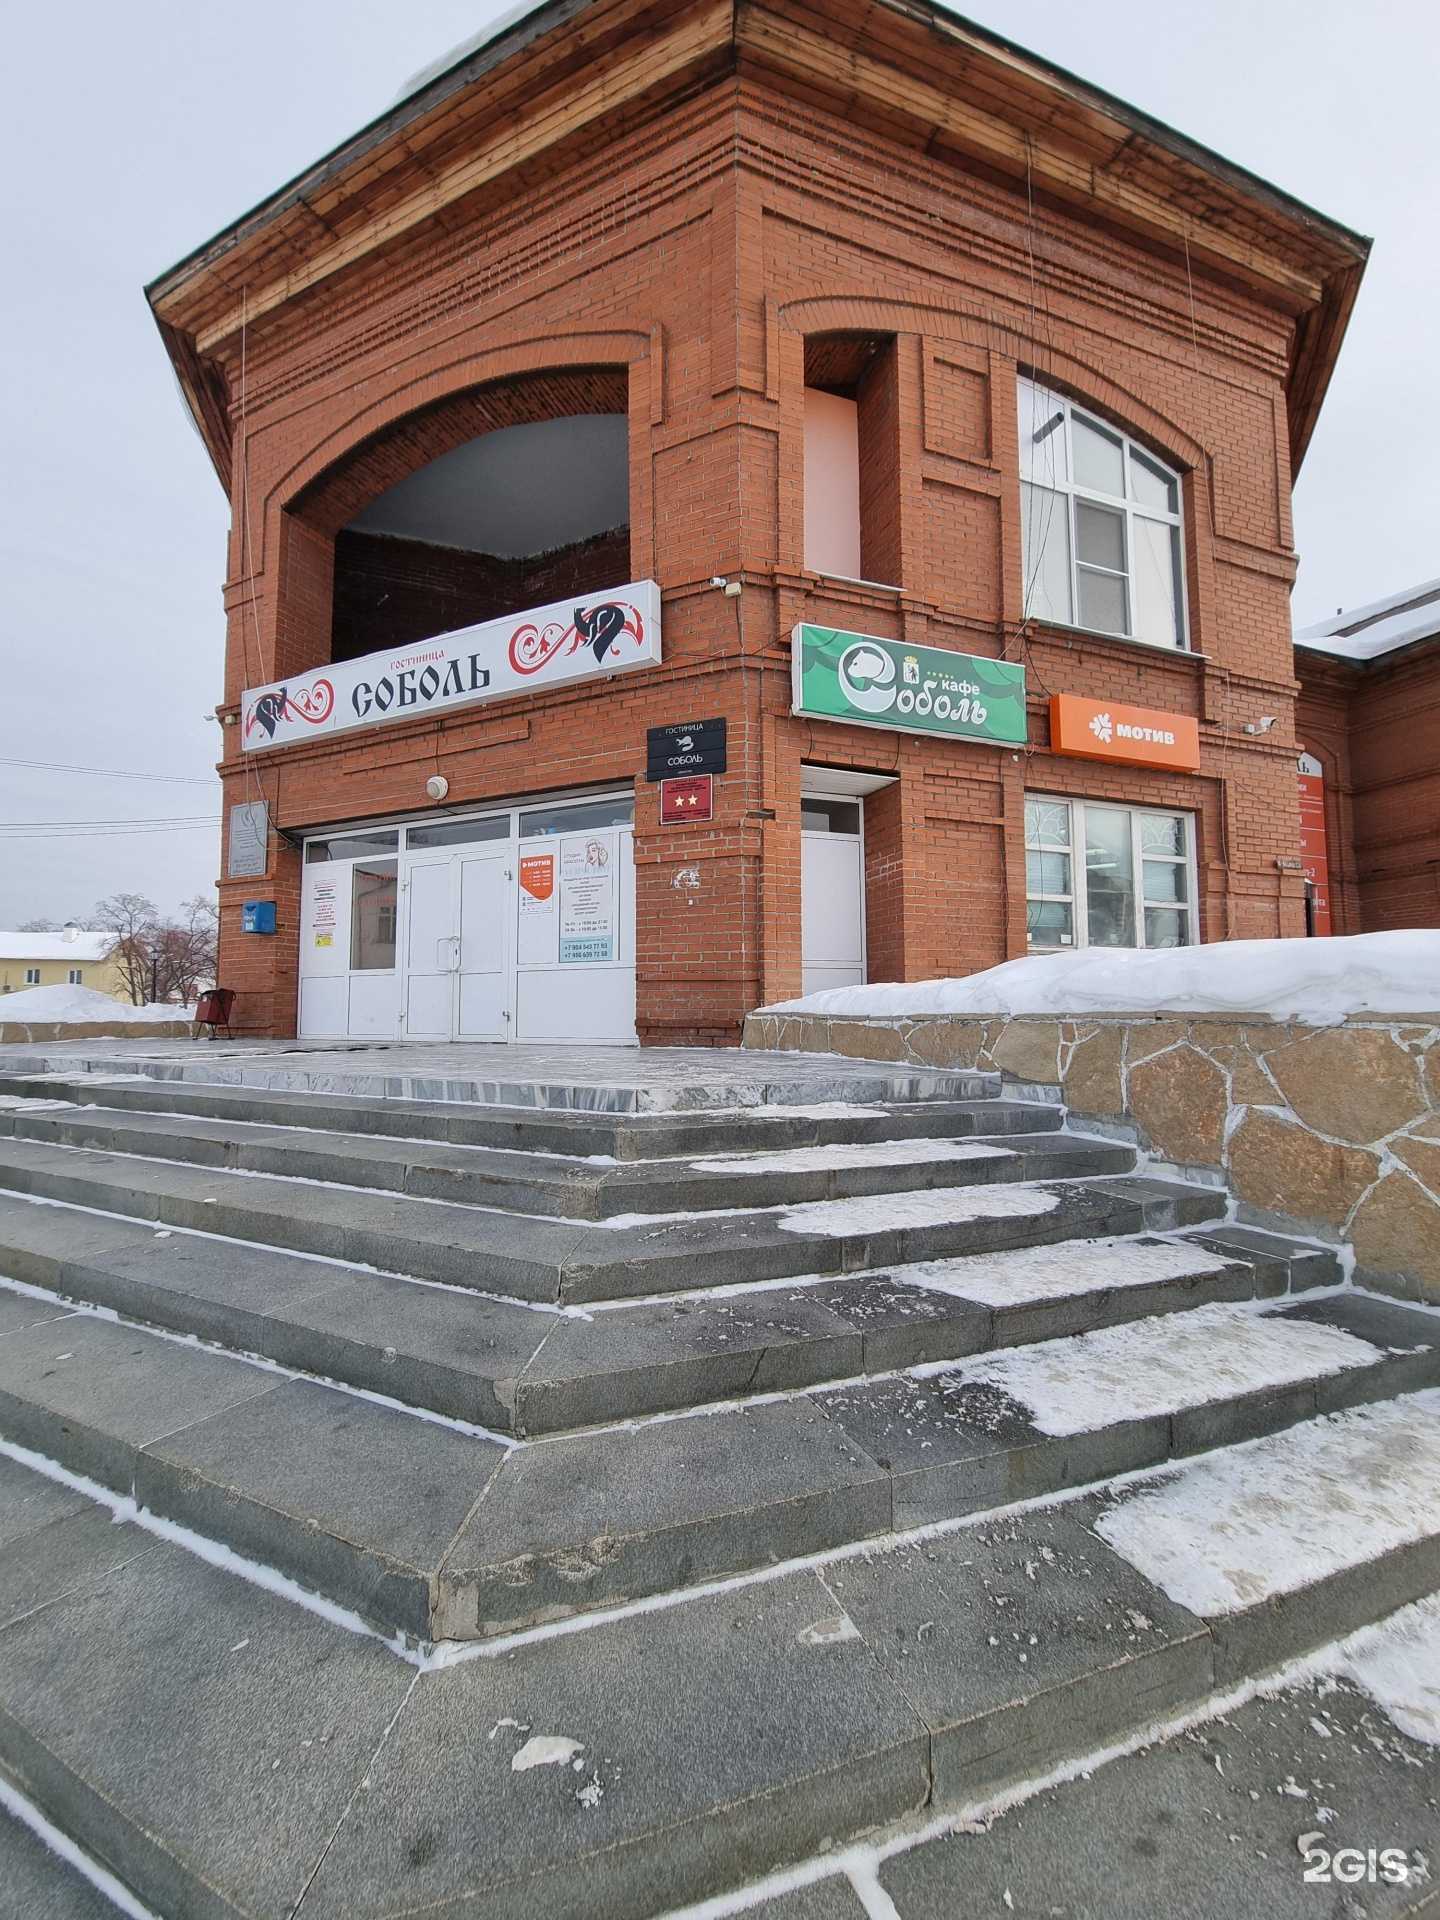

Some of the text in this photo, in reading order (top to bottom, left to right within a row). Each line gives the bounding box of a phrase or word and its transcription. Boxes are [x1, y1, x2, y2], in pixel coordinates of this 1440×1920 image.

[351, 653, 491, 718] СОБОЛЬ
[941, 678, 981, 697] кафе
[665, 723, 704, 735] ГОСТИНИЦА
[667, 753, 703, 767] СОБОЛЬ
